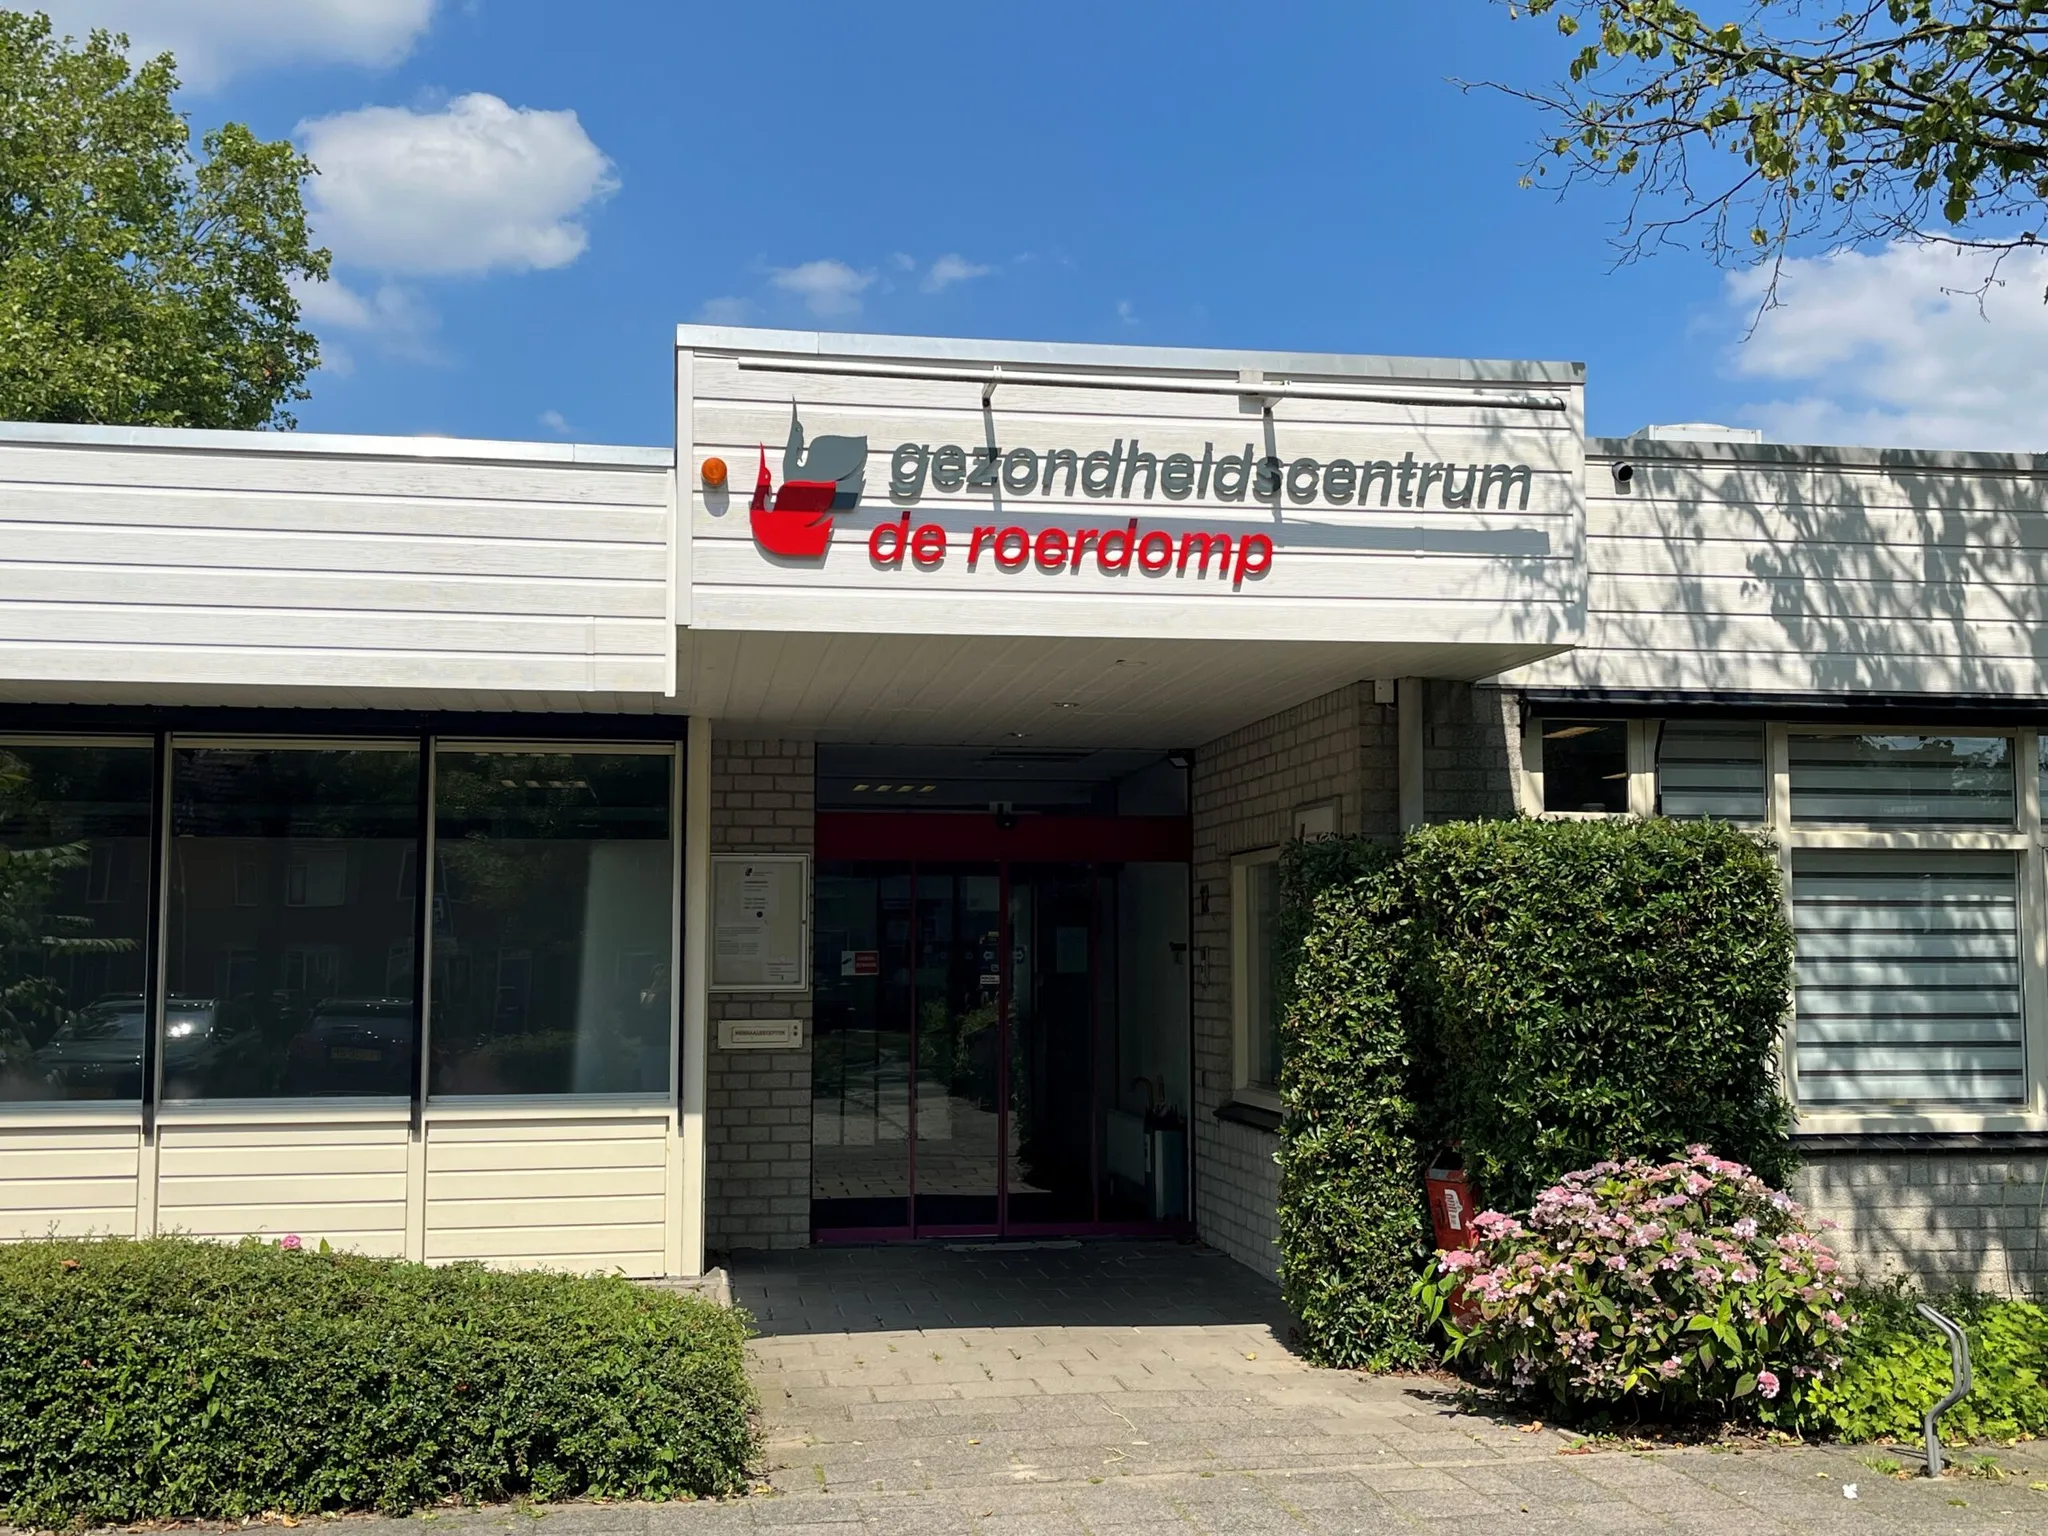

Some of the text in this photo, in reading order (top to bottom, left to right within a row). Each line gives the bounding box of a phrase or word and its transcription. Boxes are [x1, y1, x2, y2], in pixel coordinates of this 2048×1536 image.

[892, 438, 1531, 509] gezondheidscentrum
[868, 511, 1273, 584] de roerdomp
